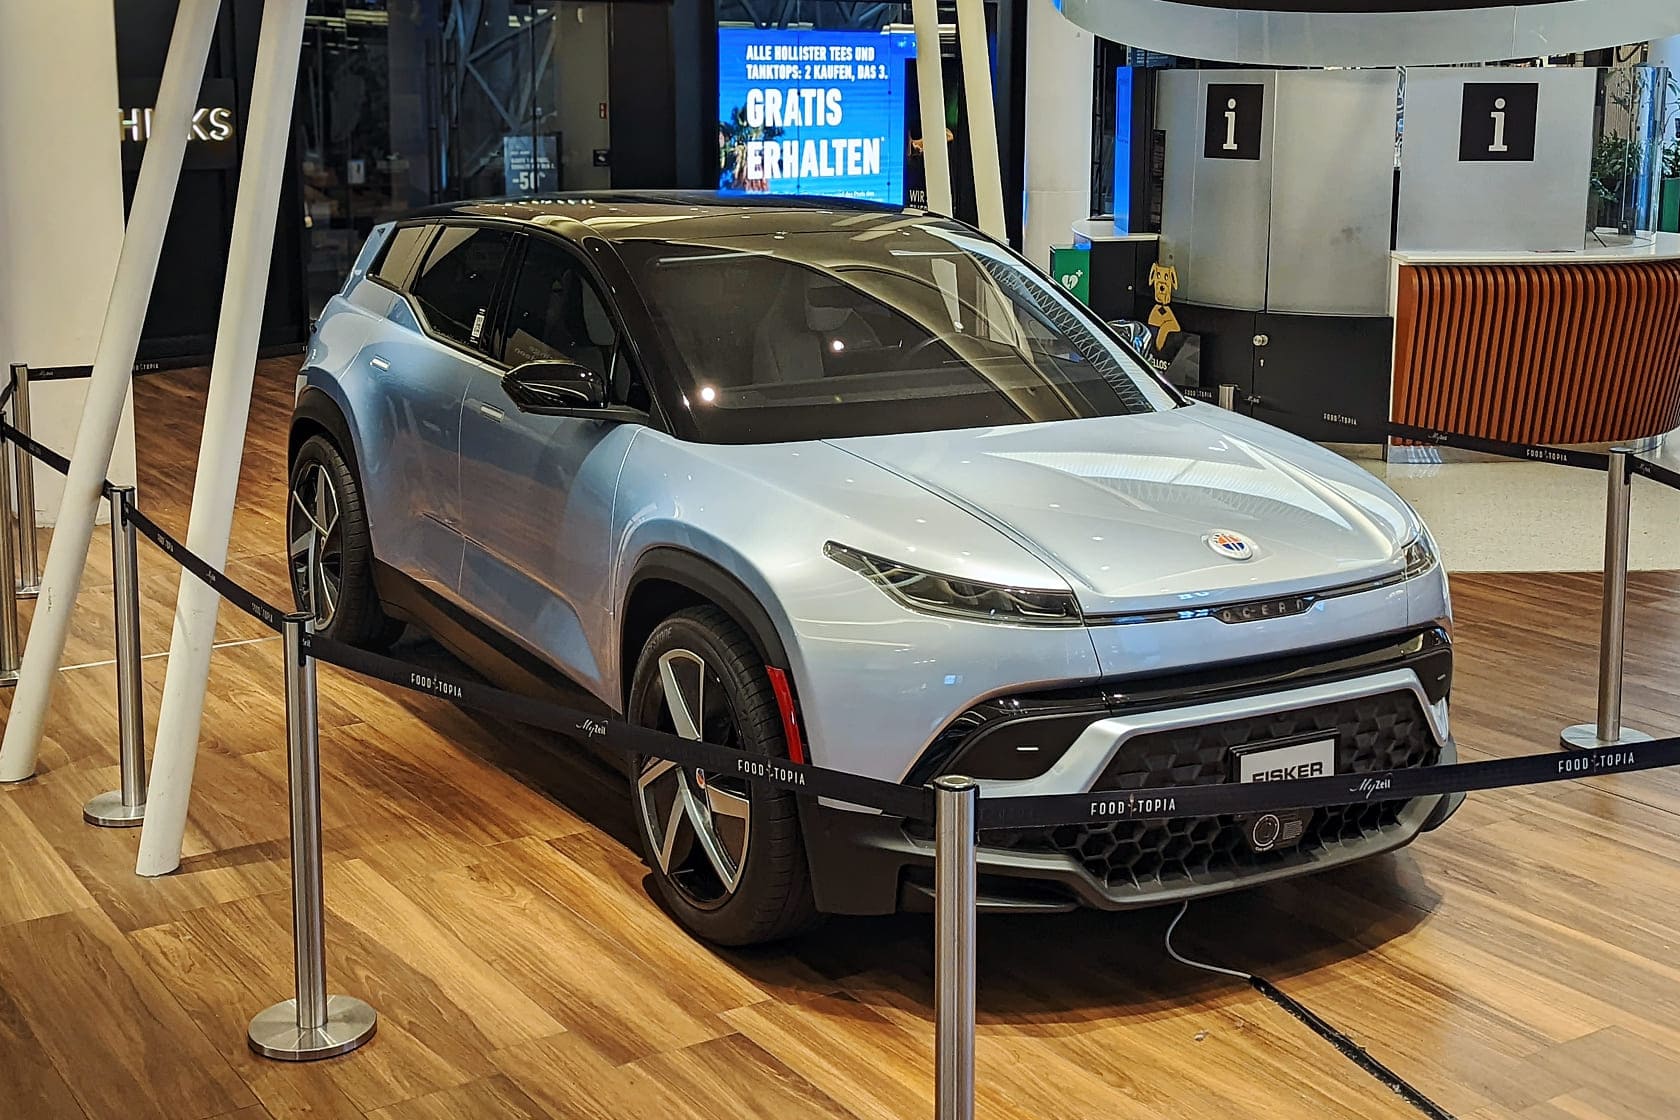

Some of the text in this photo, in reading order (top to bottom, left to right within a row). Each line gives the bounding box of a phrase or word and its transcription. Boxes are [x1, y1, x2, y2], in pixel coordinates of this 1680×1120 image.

[746, 45, 875, 61] ALLE HOLLISTER TEES UND
[746, 64, 889, 82] TANKTOPS: 2 KAUFEN, DAS 3.
[746, 88, 843, 127] GRATIS
[910, 189, 925, 203] WIR
[411, 673, 463, 698] FOOD TOPIA
[737, 759, 806, 786] FOOD TOPIA
[1252, 761, 1323, 782] FISKER
[1557, 752, 1635, 773] FOOD TOPIA
[1090, 798, 1176, 816] FOOD TOPIA
